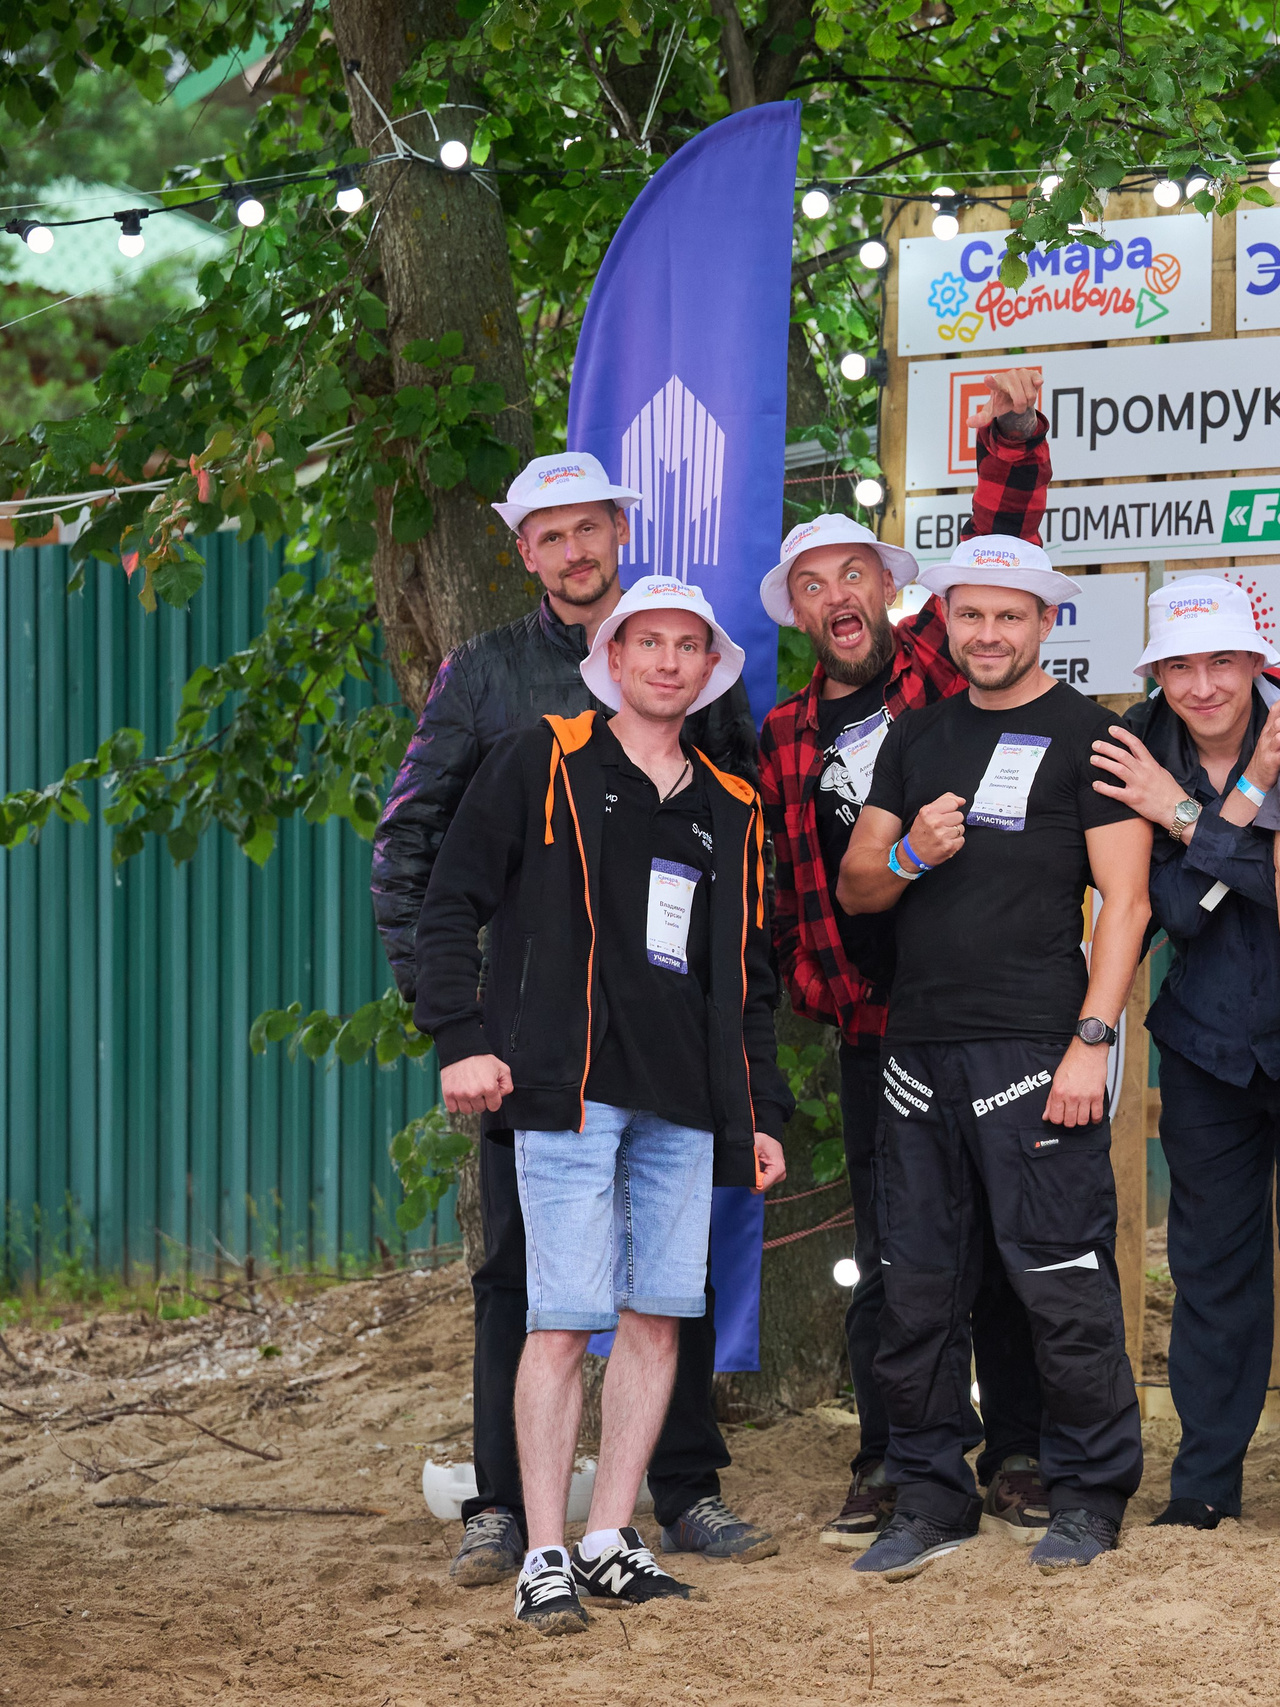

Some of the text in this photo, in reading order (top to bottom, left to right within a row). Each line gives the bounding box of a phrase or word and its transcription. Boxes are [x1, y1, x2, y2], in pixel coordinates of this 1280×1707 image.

[975, 269, 1135, 331] Фестиваль
[538, 465, 580, 479] Самара
[972, 549, 1016, 560] Самара
[1169, 598, 1213, 610] Самара
[835, 804, 856, 826] 18
[975, 814, 1015, 827] УЧАСТНИК
[653, 953, 681, 969] УЧАСТНИК
[888, 1056, 934, 1099] Профсоюз
[882, 1068, 930, 1113] электриков
[971, 1069, 1052, 1118] Brodeks
[883, 1086, 911, 1118] Казани
